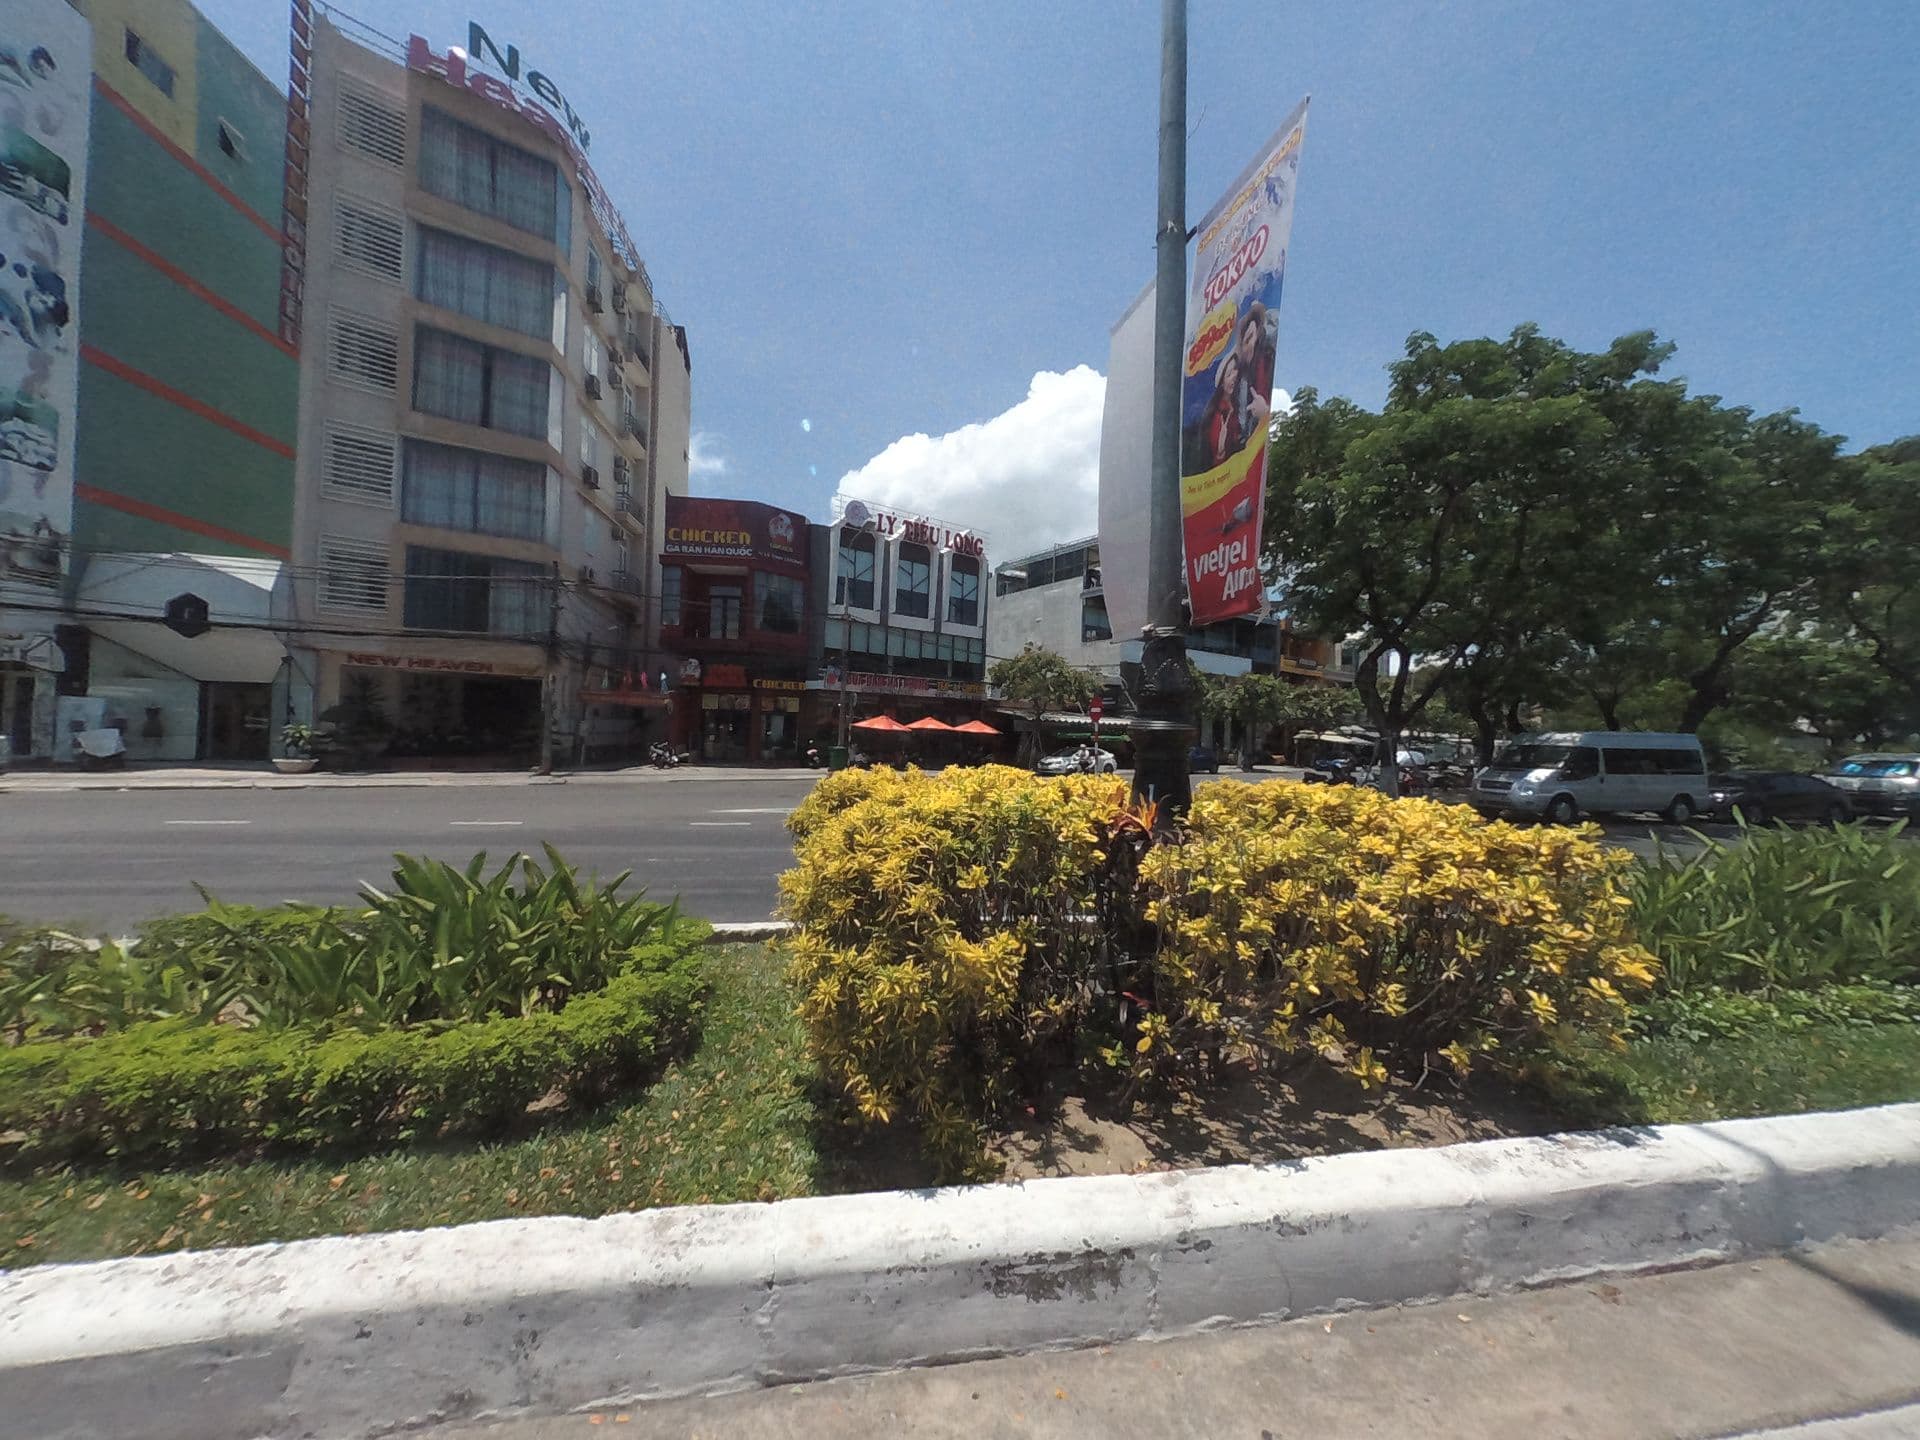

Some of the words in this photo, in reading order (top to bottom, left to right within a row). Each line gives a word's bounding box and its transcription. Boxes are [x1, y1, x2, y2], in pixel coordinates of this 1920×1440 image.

[468, 20, 590, 152] New
[1204, 224, 1269, 313] TOKYO
[945, 530, 984, 556] LONG
[349, 653, 400, 667] NEW
[408, 657, 493, 673] HEAVEN
[752, 679, 806, 690] CHICKEN
